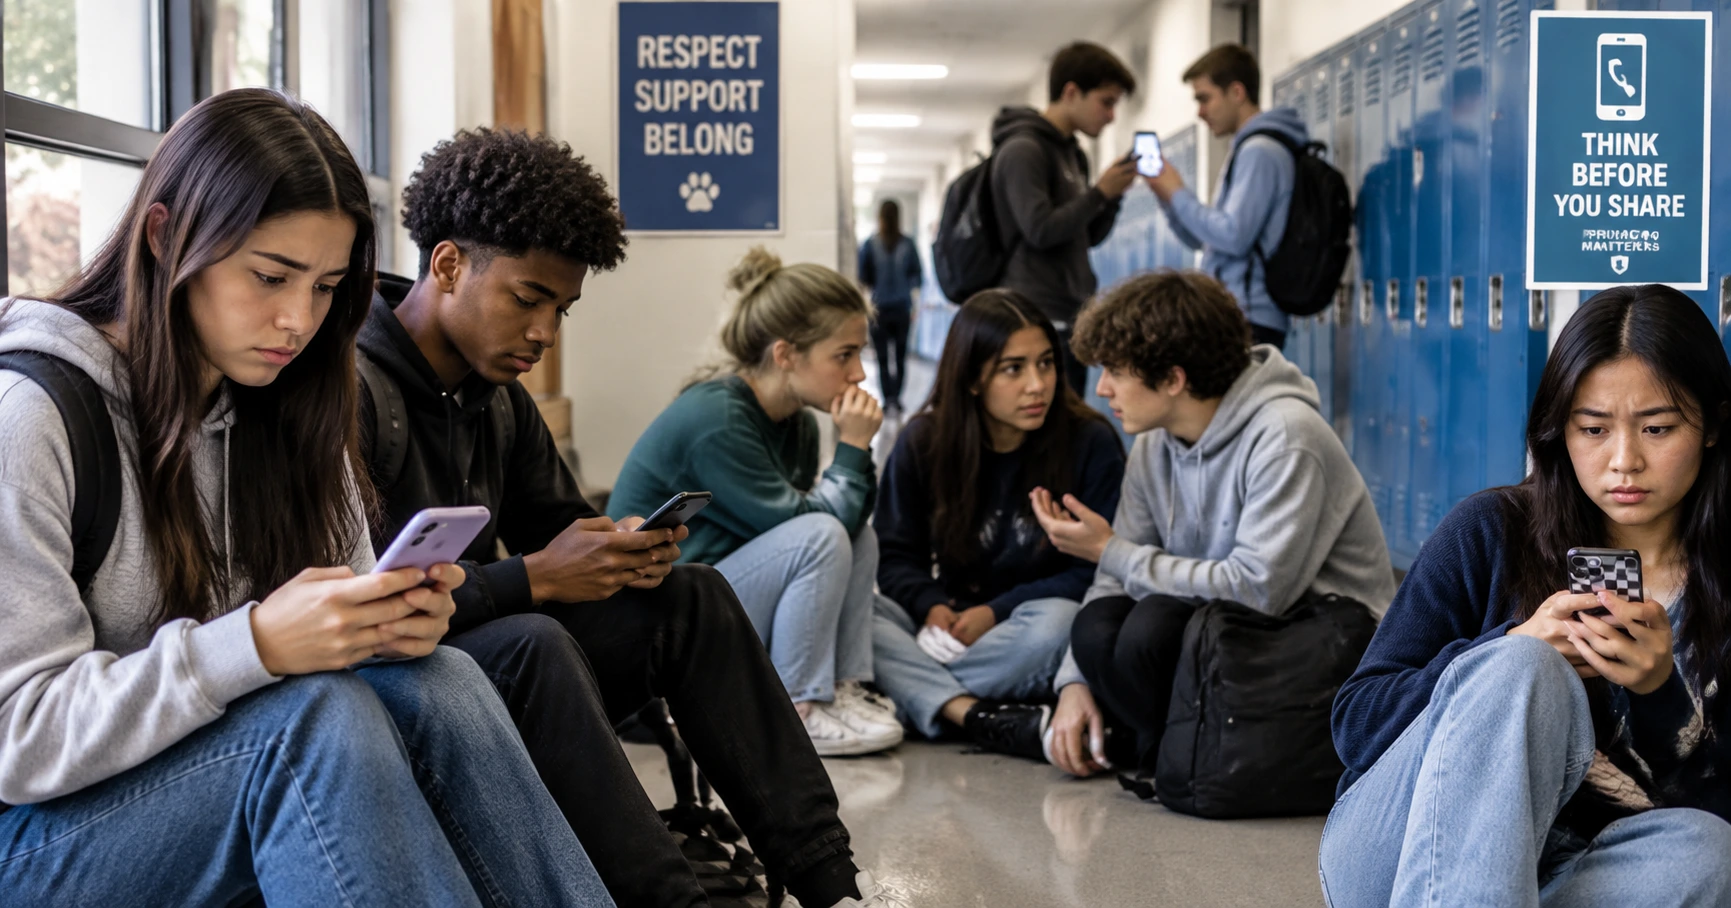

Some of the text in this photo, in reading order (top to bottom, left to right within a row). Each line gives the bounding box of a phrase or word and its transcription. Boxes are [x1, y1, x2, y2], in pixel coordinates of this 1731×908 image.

[637, 35, 761, 69] RESPECT
[634, 79, 764, 112] SUPPORT
[644, 122, 754, 156] BELONG
[1581, 132, 1659, 156] THINK
[1572, 162, 1668, 187] BEFORE
[1553, 194, 1685, 217] YOU SHARE
